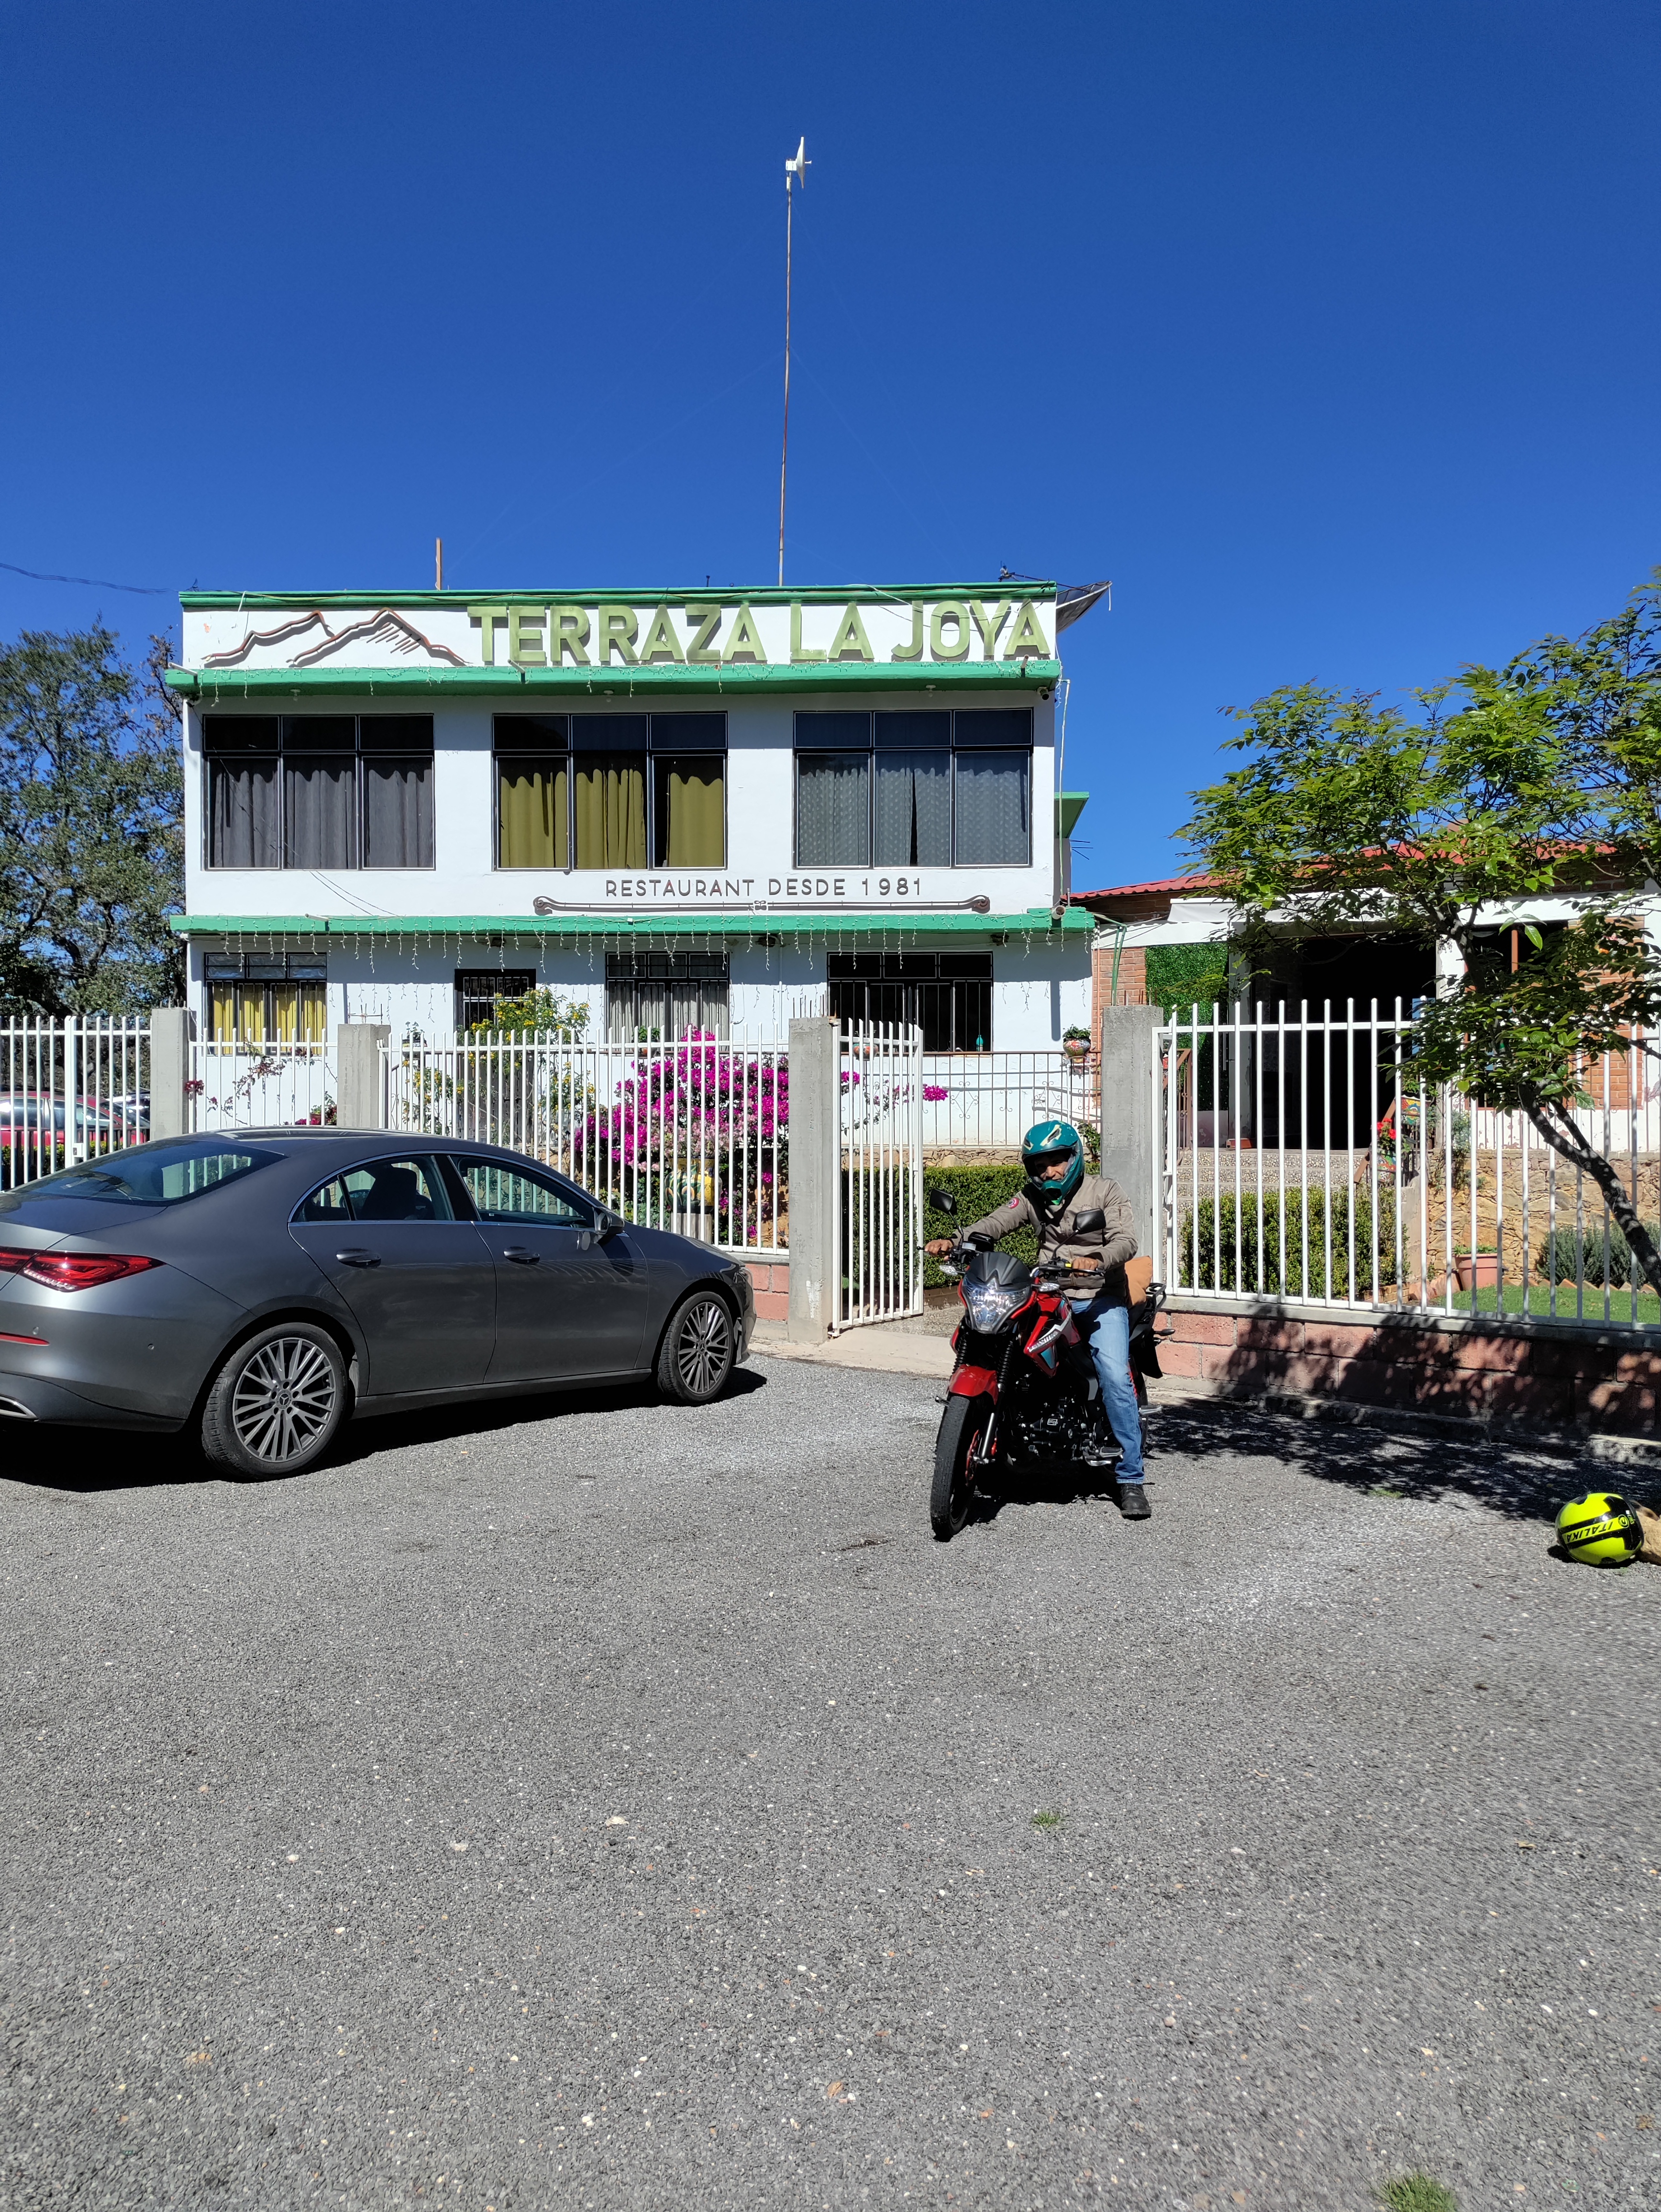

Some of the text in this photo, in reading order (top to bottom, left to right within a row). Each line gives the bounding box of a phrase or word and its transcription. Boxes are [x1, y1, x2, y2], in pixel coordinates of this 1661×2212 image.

[467, 598, 1051, 662] TERRAZA LA JOYA
[606, 877, 920, 897] RESTAURANT DESDE 1981
[1567, 1521, 1613, 1542] ITALIKA
